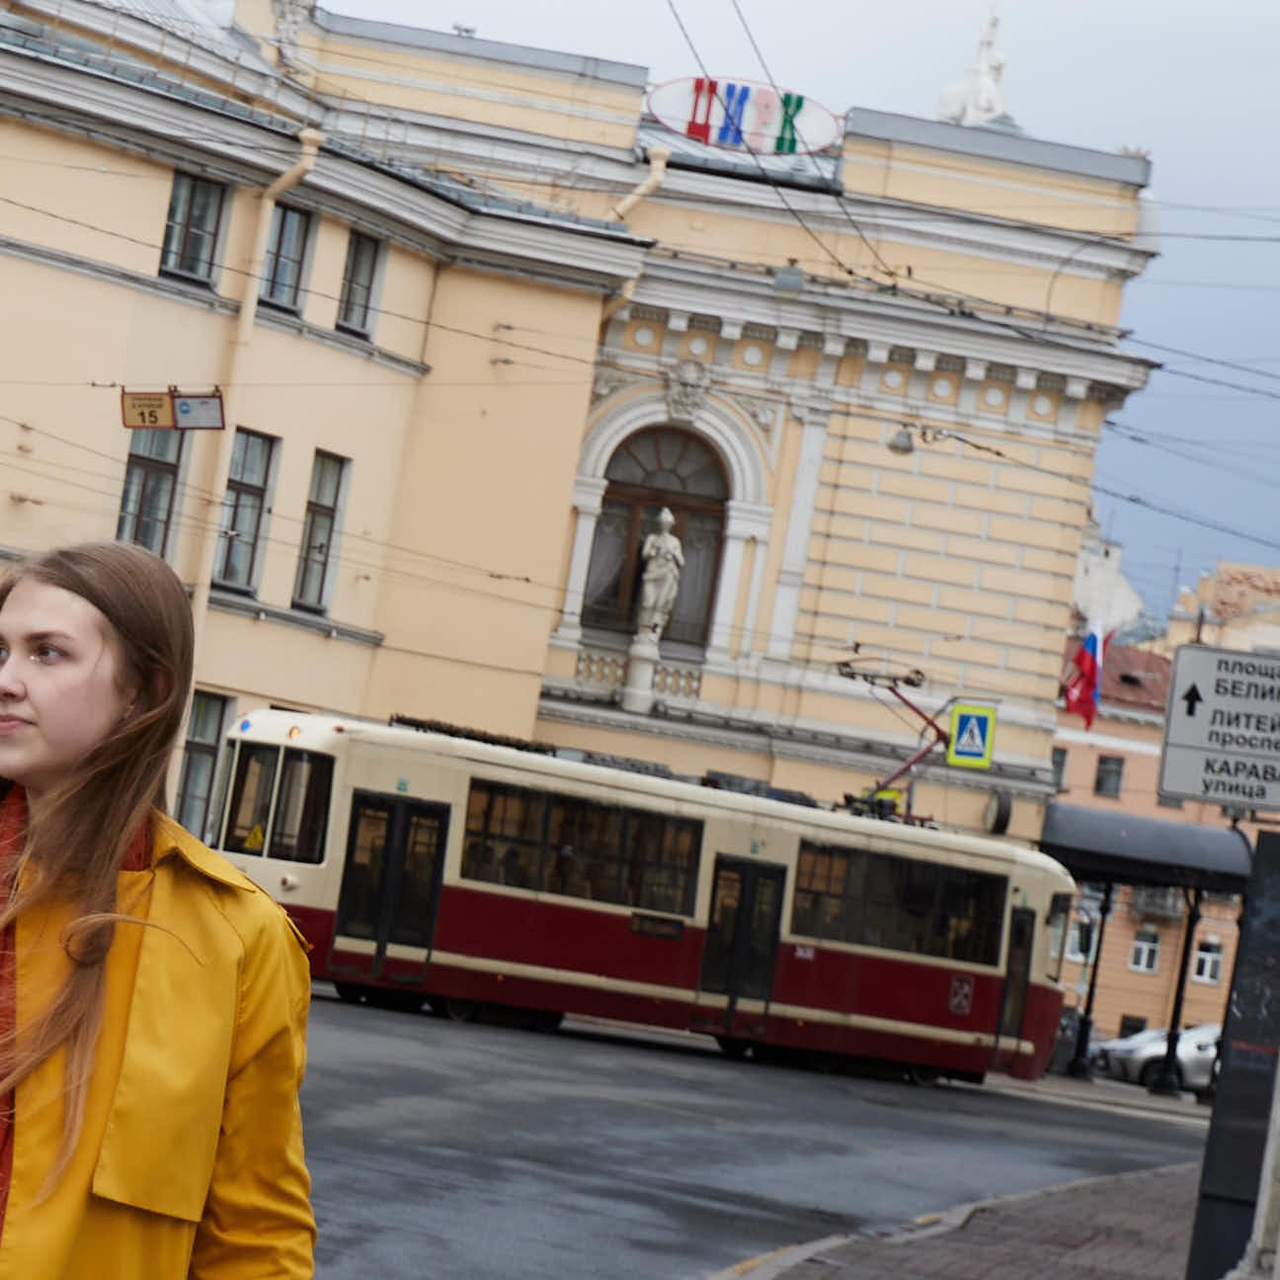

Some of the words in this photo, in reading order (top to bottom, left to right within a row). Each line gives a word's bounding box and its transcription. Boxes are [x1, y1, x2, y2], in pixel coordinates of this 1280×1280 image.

[686, 78, 804, 153] ЦИРК
[138, 410, 158, 424] 15
[1214, 678, 1280, 701] БЕЛИ
[1204, 758, 1280, 782] КАРАВ
[1202, 779, 1266, 799] улица
